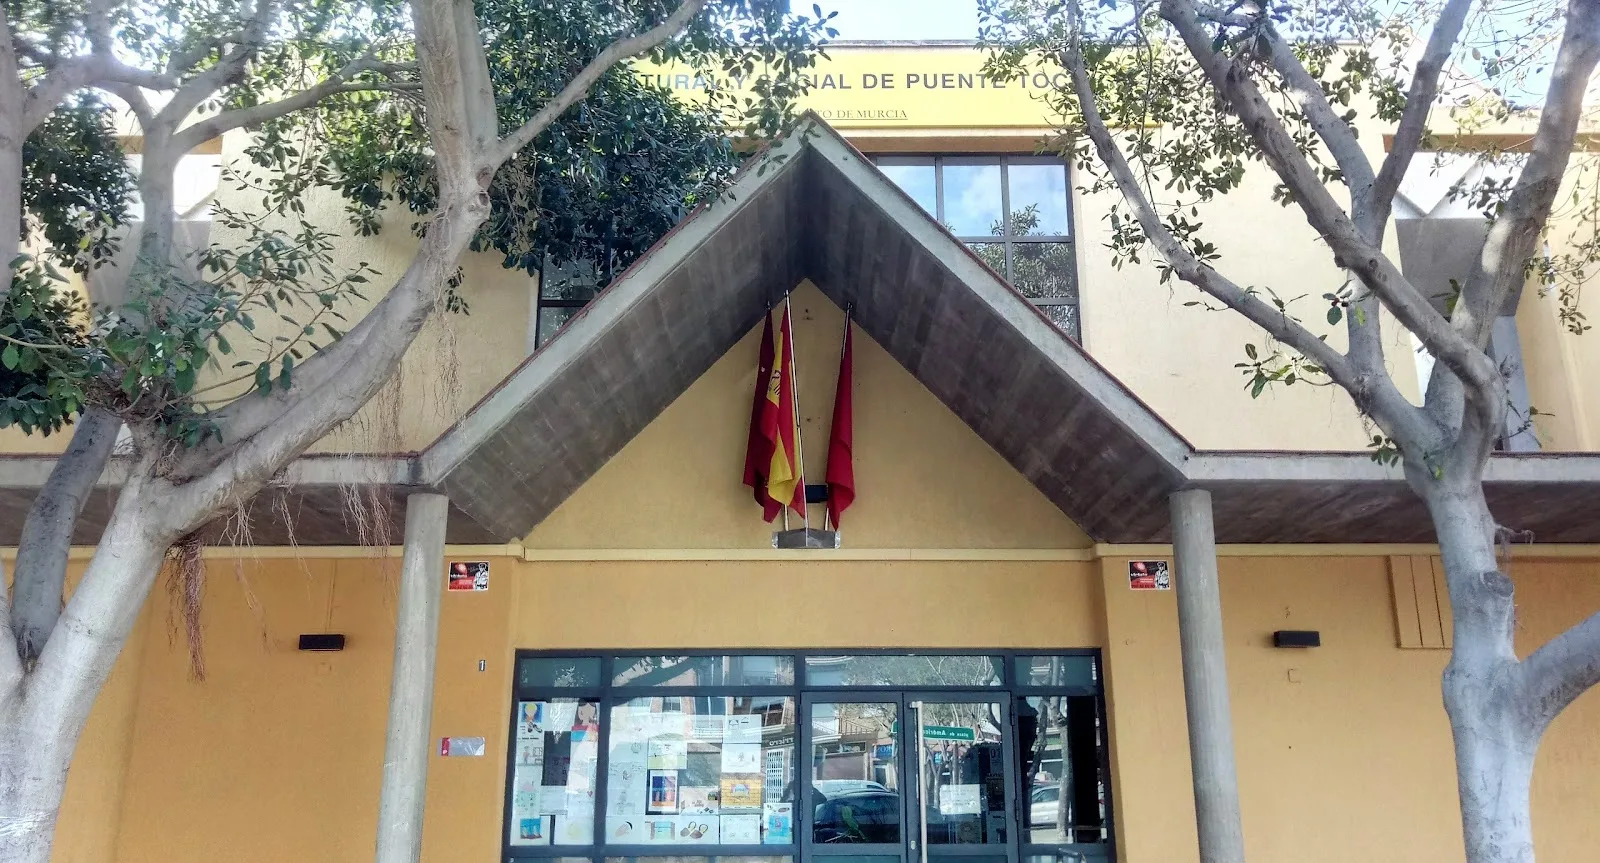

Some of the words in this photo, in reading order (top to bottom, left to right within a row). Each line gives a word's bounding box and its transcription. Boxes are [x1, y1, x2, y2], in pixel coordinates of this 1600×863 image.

[640, 73, 719, 90] TURAL
[862, 73, 895, 89] DE
[906, 73, 1005, 89] PUENTE
[1016, 72, 1068, 89] TOC
[837, 109, 854, 118] DE
[855, 109, 908, 119] MURCIA
